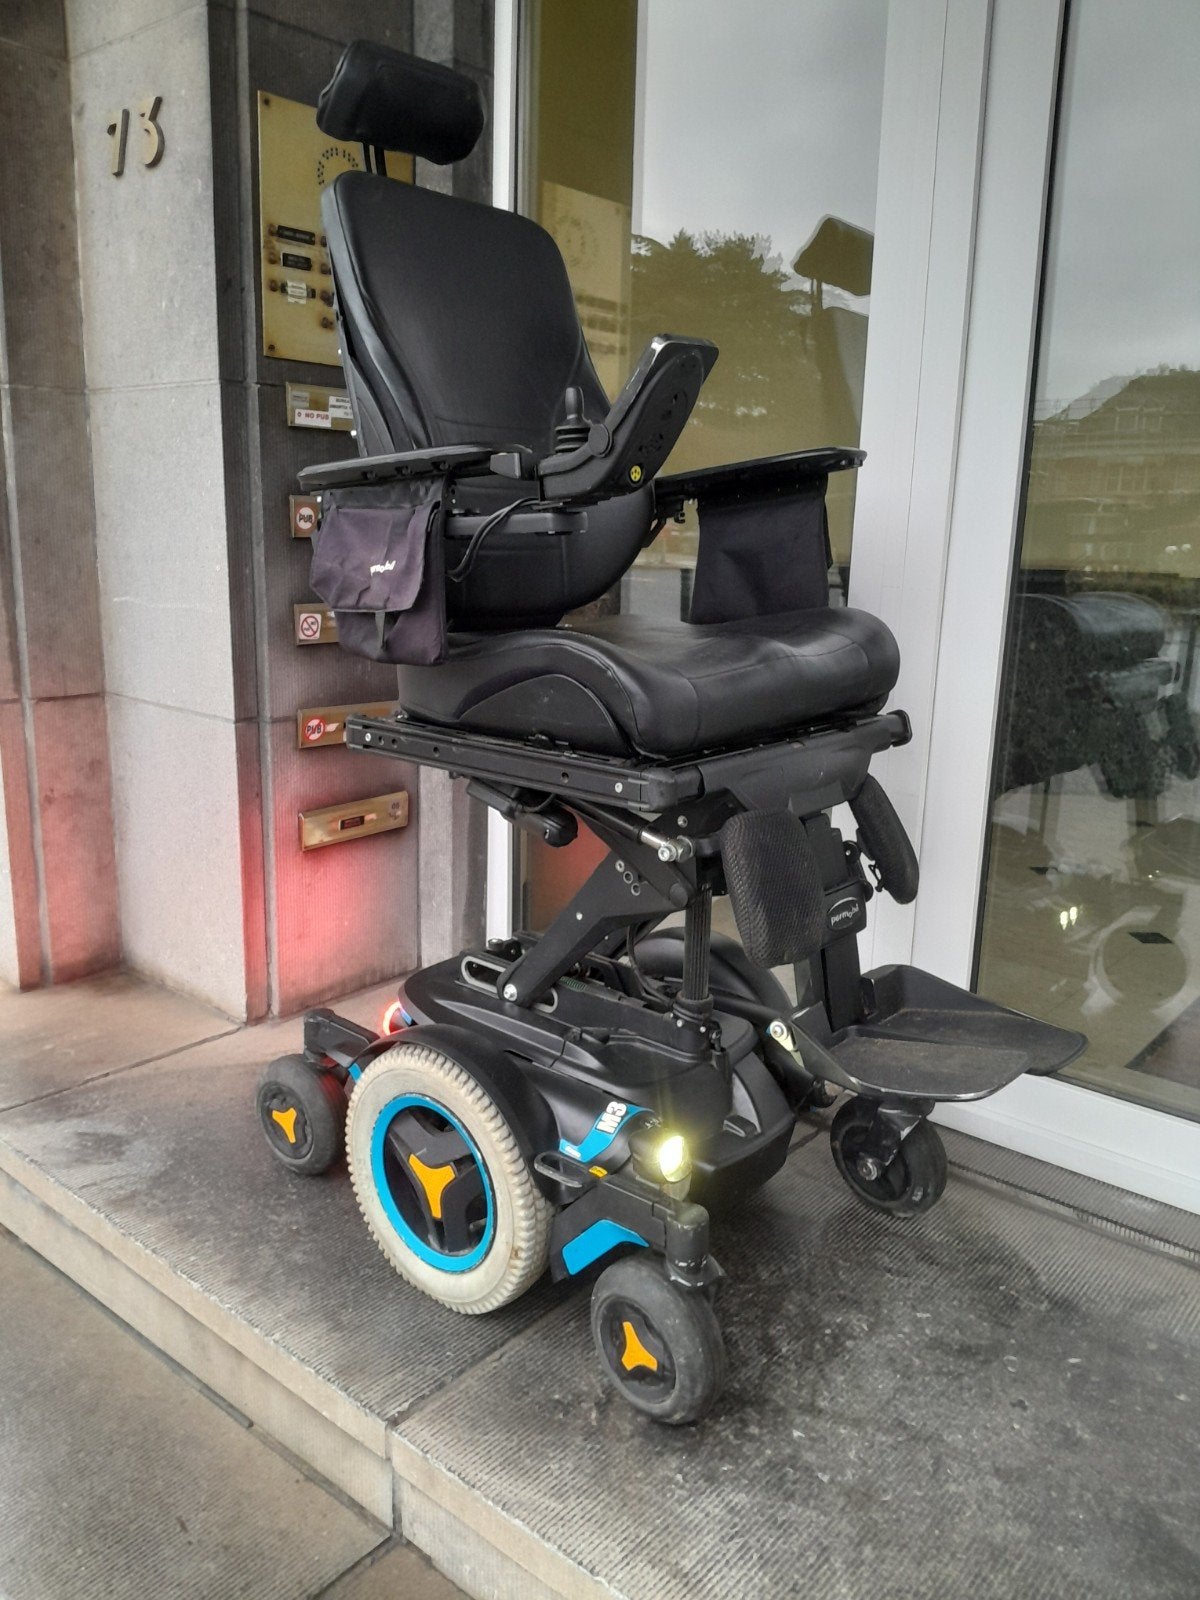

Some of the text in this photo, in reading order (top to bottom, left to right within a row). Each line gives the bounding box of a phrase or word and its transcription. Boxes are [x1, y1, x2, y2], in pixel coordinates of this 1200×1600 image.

[298, 513, 314, 524] PUB
[306, 724, 322, 736] PUB
[830, 902, 859, 927] permobil
[595, 1101, 627, 1134] M3
